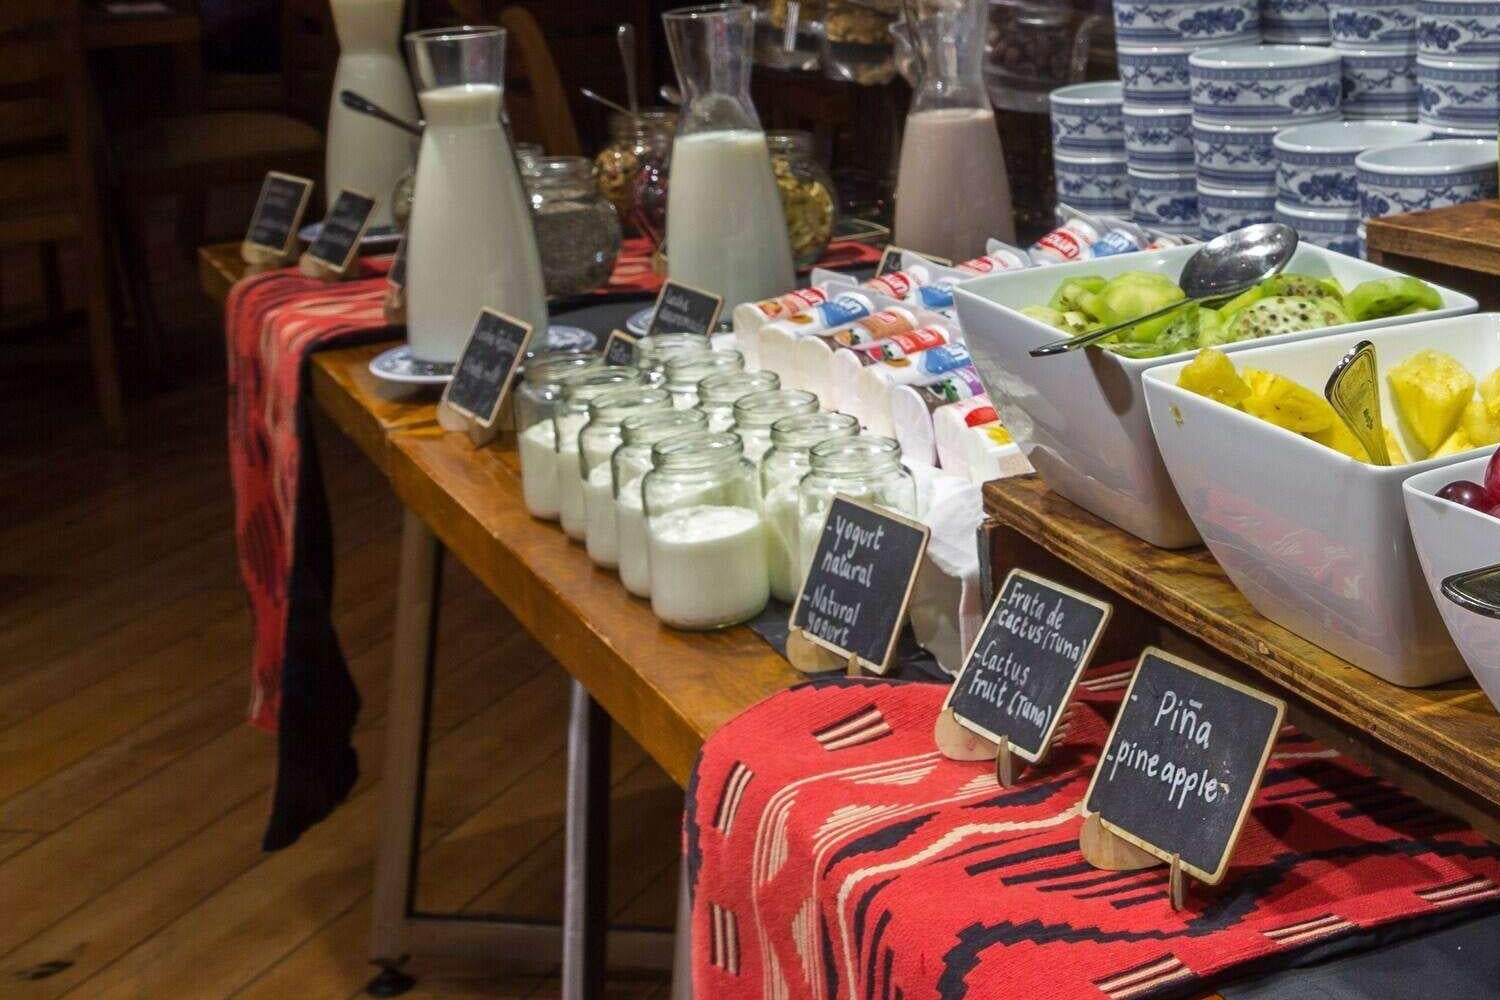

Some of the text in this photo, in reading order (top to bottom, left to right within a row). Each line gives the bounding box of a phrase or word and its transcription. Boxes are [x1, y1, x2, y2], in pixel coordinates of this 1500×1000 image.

[821, 551, 875, 588] natural
[1046, 598, 1065, 630] de
[968, 669, 1009, 707] Fruit
[1154, 690, 1212, 750] Piña
